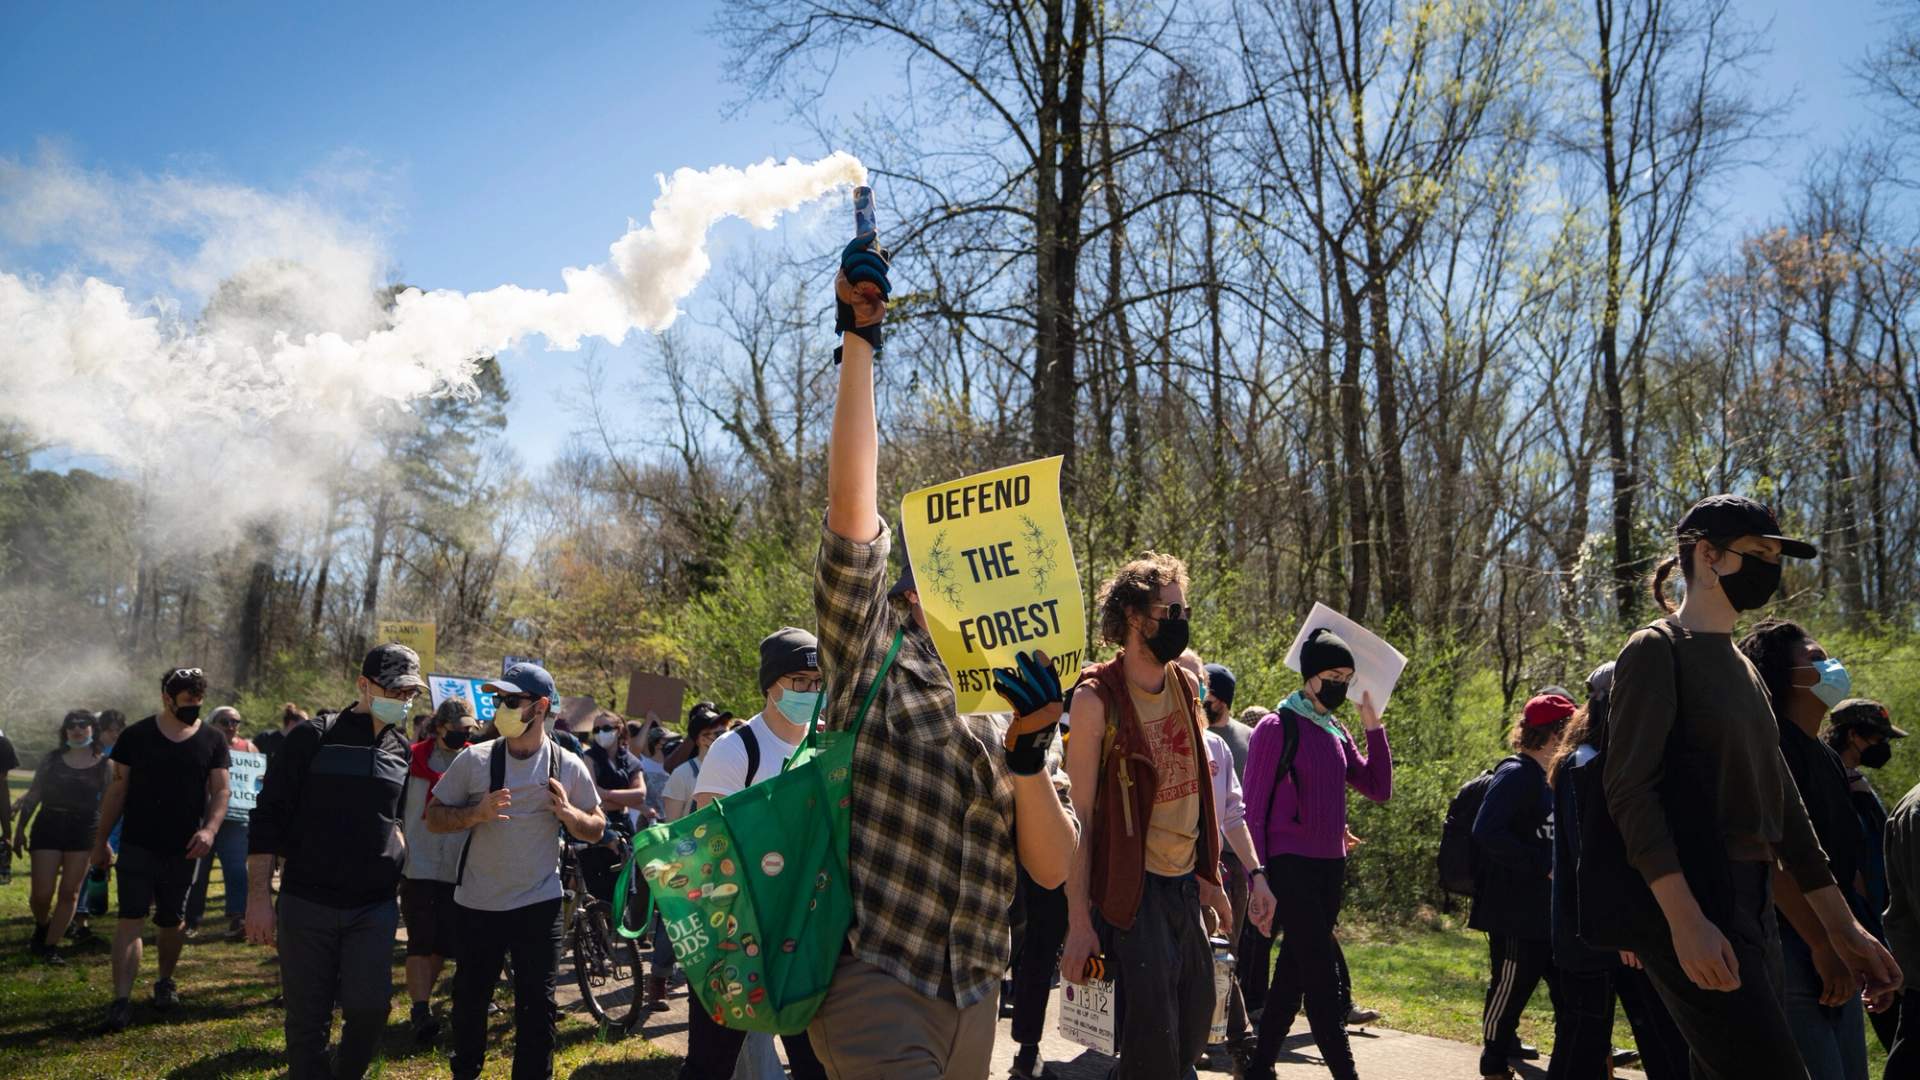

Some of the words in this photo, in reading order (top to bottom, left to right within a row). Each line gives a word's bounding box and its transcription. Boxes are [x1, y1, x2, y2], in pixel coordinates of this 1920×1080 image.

[927, 475, 1030, 524] DEFEND
[961, 541, 1020, 583] THE
[959, 599, 1062, 653] FOREST
[957, 649, 1082, 693] #STCITY
[229, 772, 249, 782] THE
[231, 758, 261, 769] UND
[1095, 993, 1110, 1017] 12
